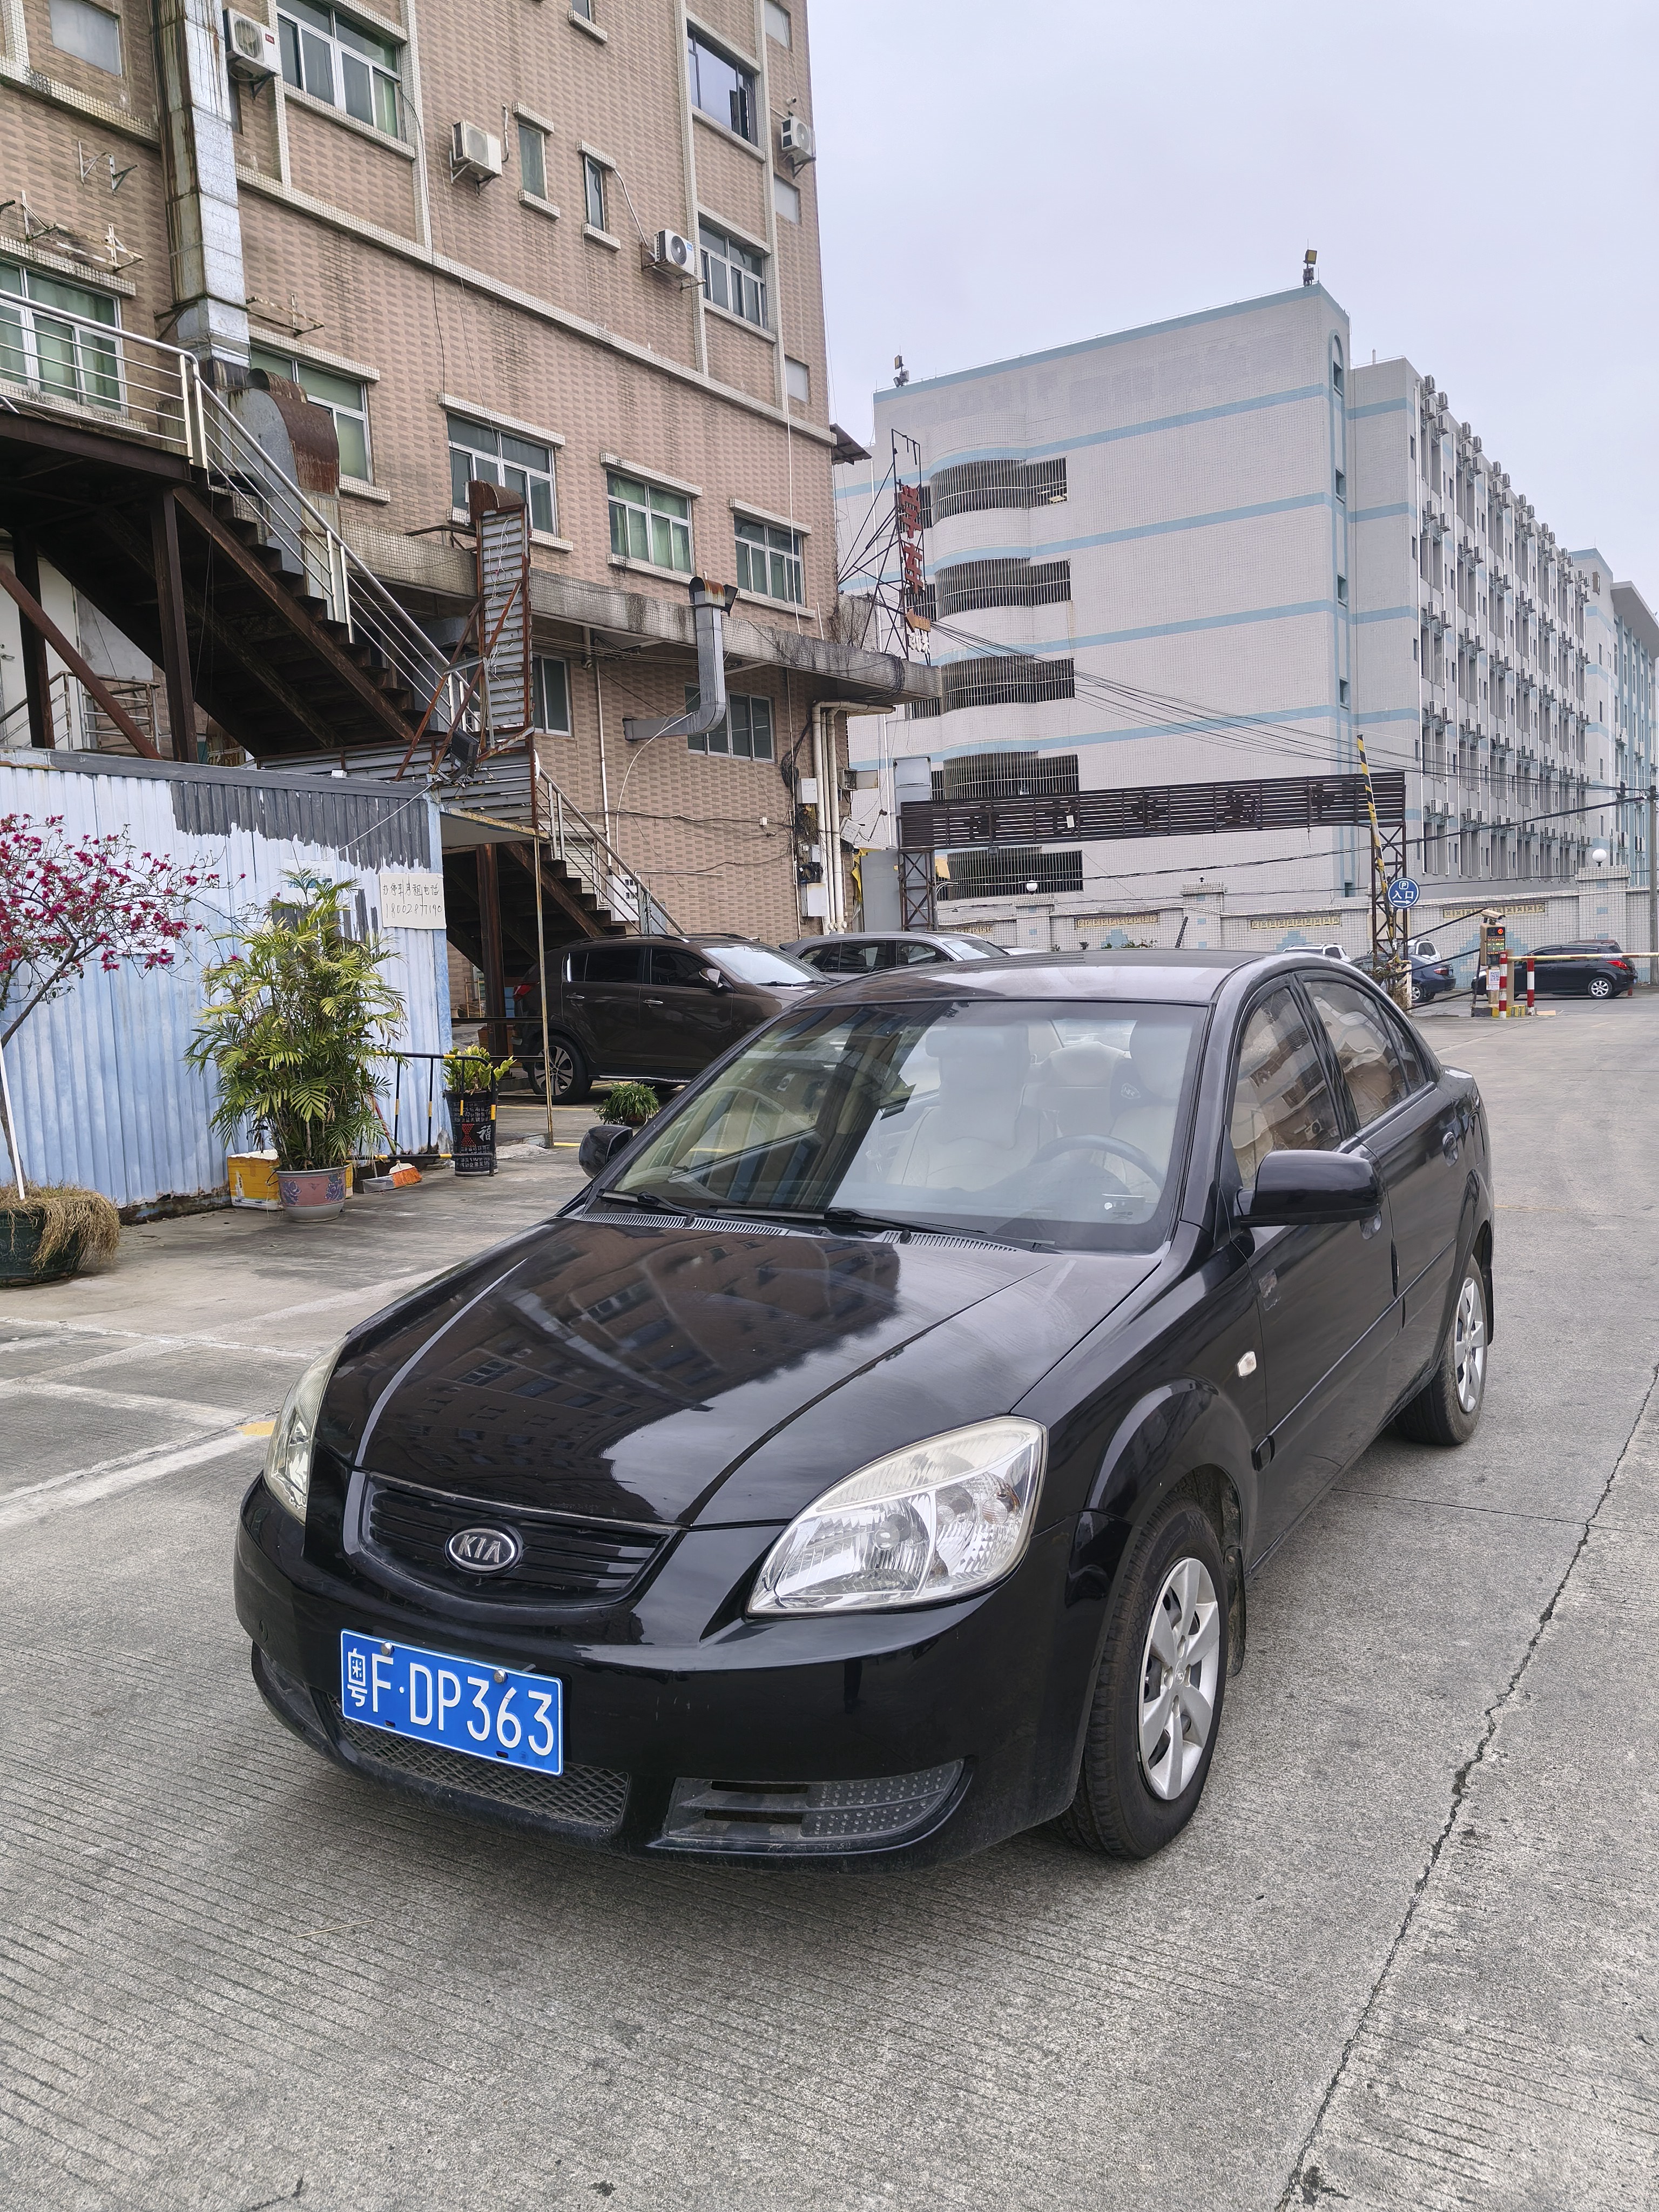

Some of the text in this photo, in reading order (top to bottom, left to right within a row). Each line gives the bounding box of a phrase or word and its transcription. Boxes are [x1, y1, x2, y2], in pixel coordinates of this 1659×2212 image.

[900, 485, 924, 594] 学车
[1392, 890, 1414, 899] 入口
[458, 1534, 501, 1563] KIA
[347, 1648, 554, 1756] 粤F·DP363
